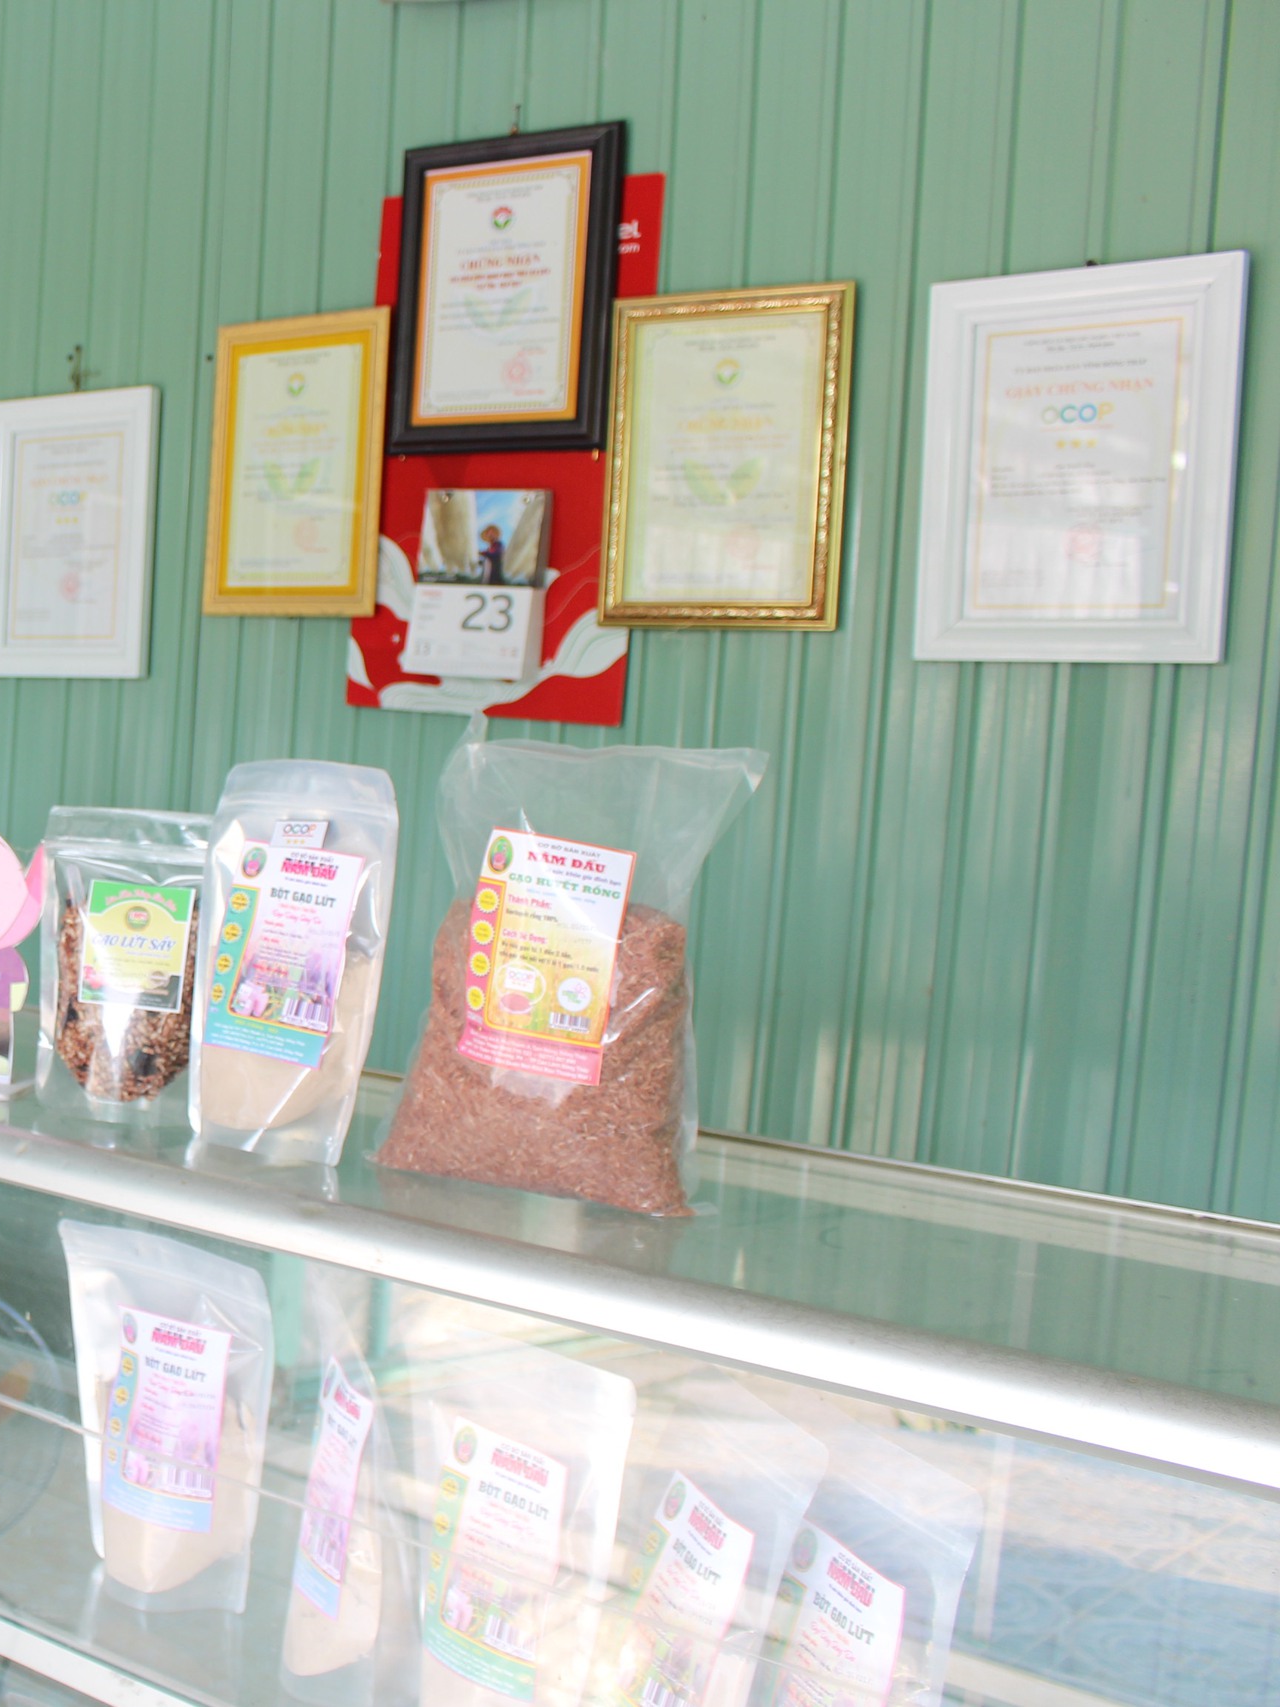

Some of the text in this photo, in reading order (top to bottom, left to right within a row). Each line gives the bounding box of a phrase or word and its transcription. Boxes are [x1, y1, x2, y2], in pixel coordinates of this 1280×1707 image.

[1041, 402, 1115, 425] OCOP
[461, 593, 513, 632] 23
[283, 823, 317, 835] OCOP
